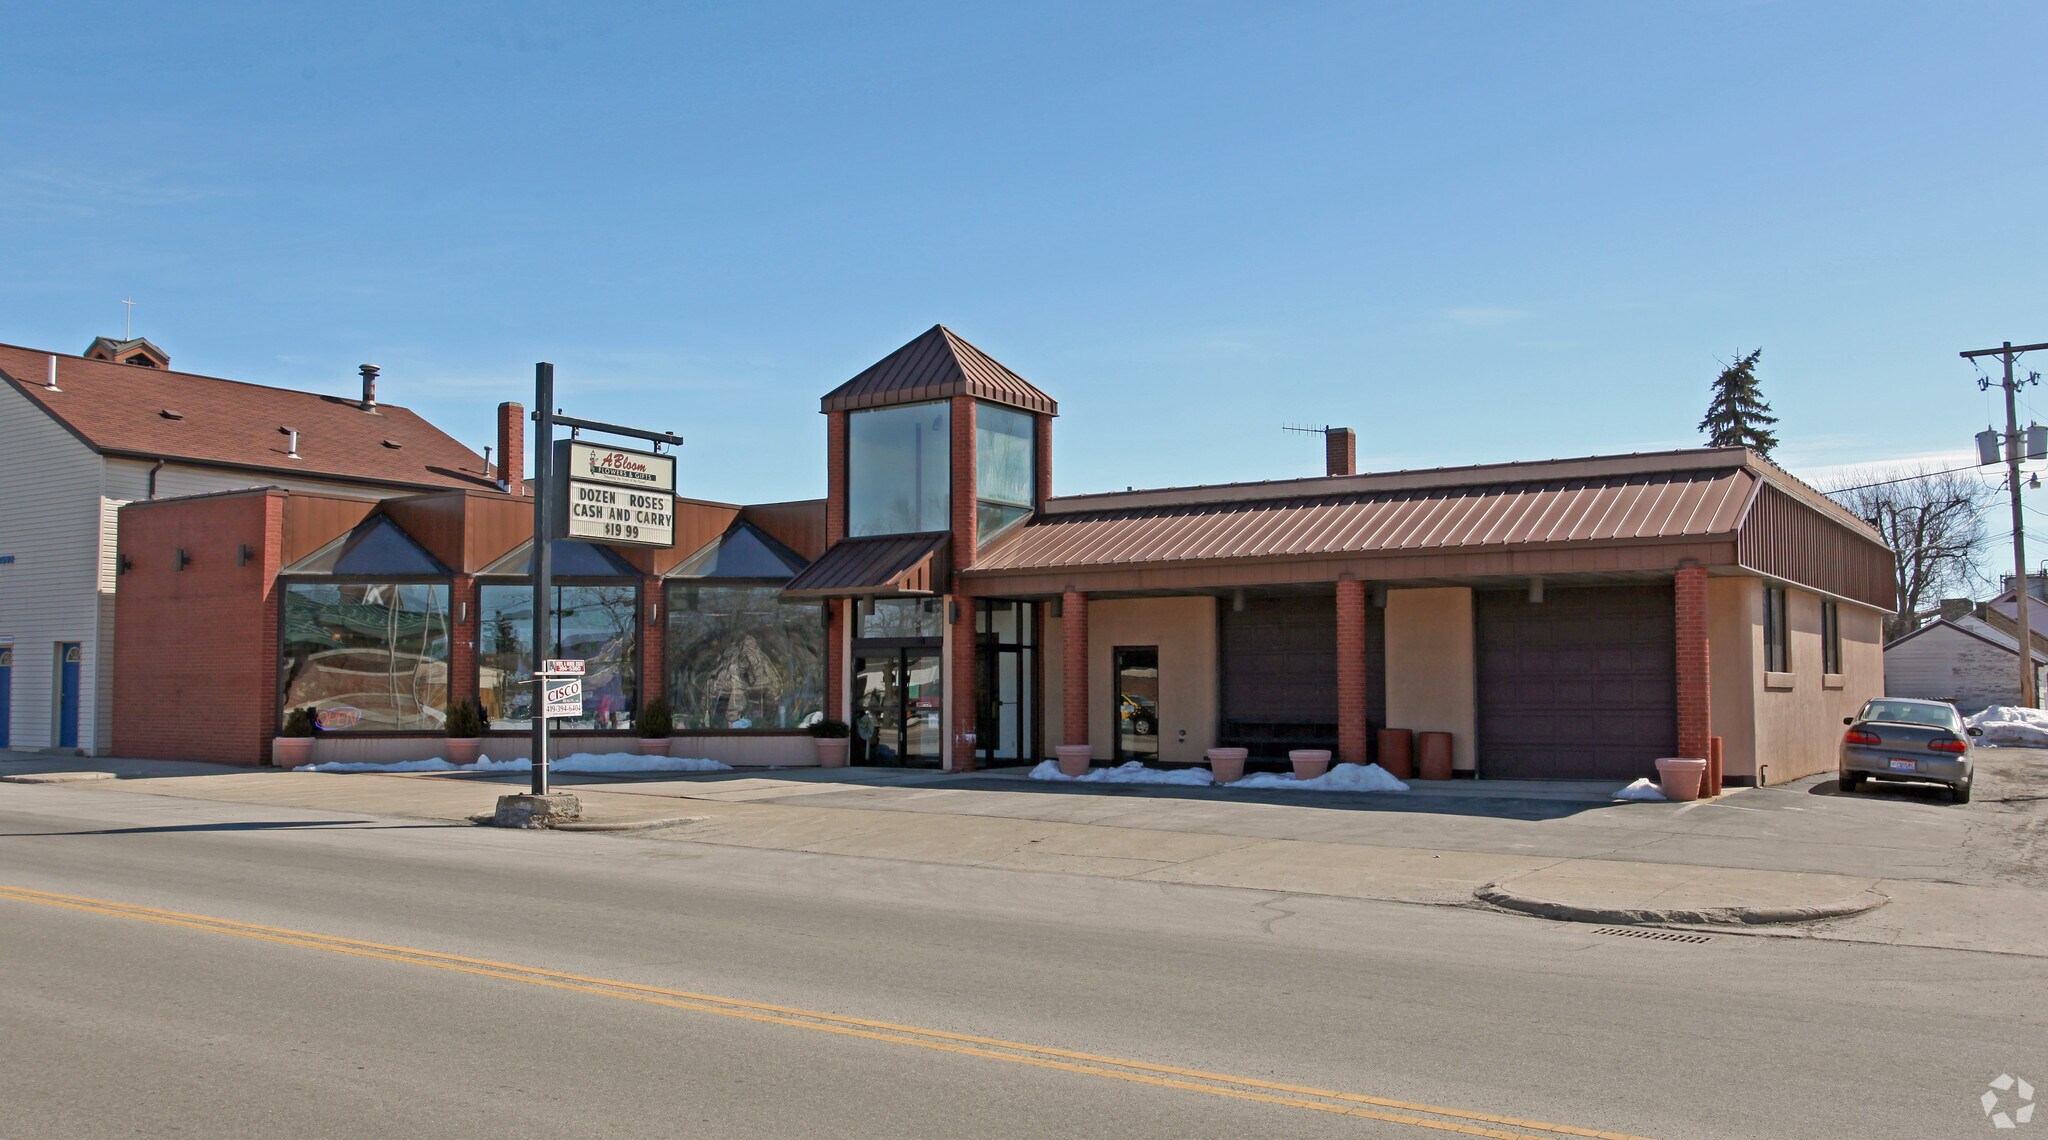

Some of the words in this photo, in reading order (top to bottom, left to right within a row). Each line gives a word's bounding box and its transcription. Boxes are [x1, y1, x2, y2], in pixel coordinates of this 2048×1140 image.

[598, 466, 627, 477] FLOWERS
[634, 473, 652, 481] GIFTS
[580, 488, 616, 504] DOZEN
[629, 494, 664, 511] ROSES
[573, 503, 603, 519] CASH
[609, 508, 631, 522] AND
[636, 511, 672, 526] CARRY
[547, 683, 579, 702] CISCO
[546, 704, 581, 713] 419-394-6404
[317, 710, 358, 727] OPEN
